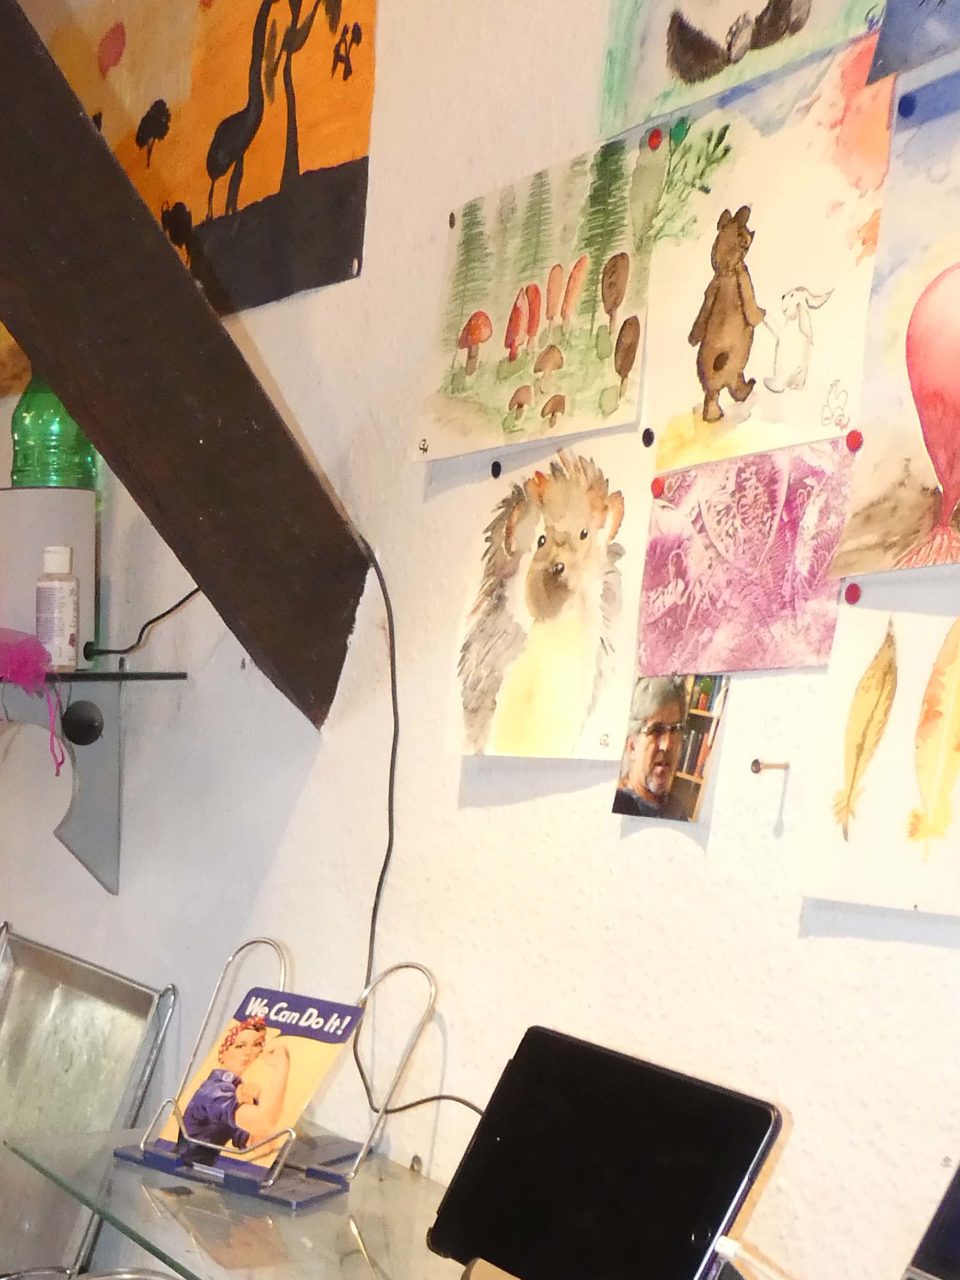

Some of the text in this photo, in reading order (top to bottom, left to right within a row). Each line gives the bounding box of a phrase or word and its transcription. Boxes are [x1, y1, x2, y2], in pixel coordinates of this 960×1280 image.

[245, 996, 352, 1035] We Can Do It!
